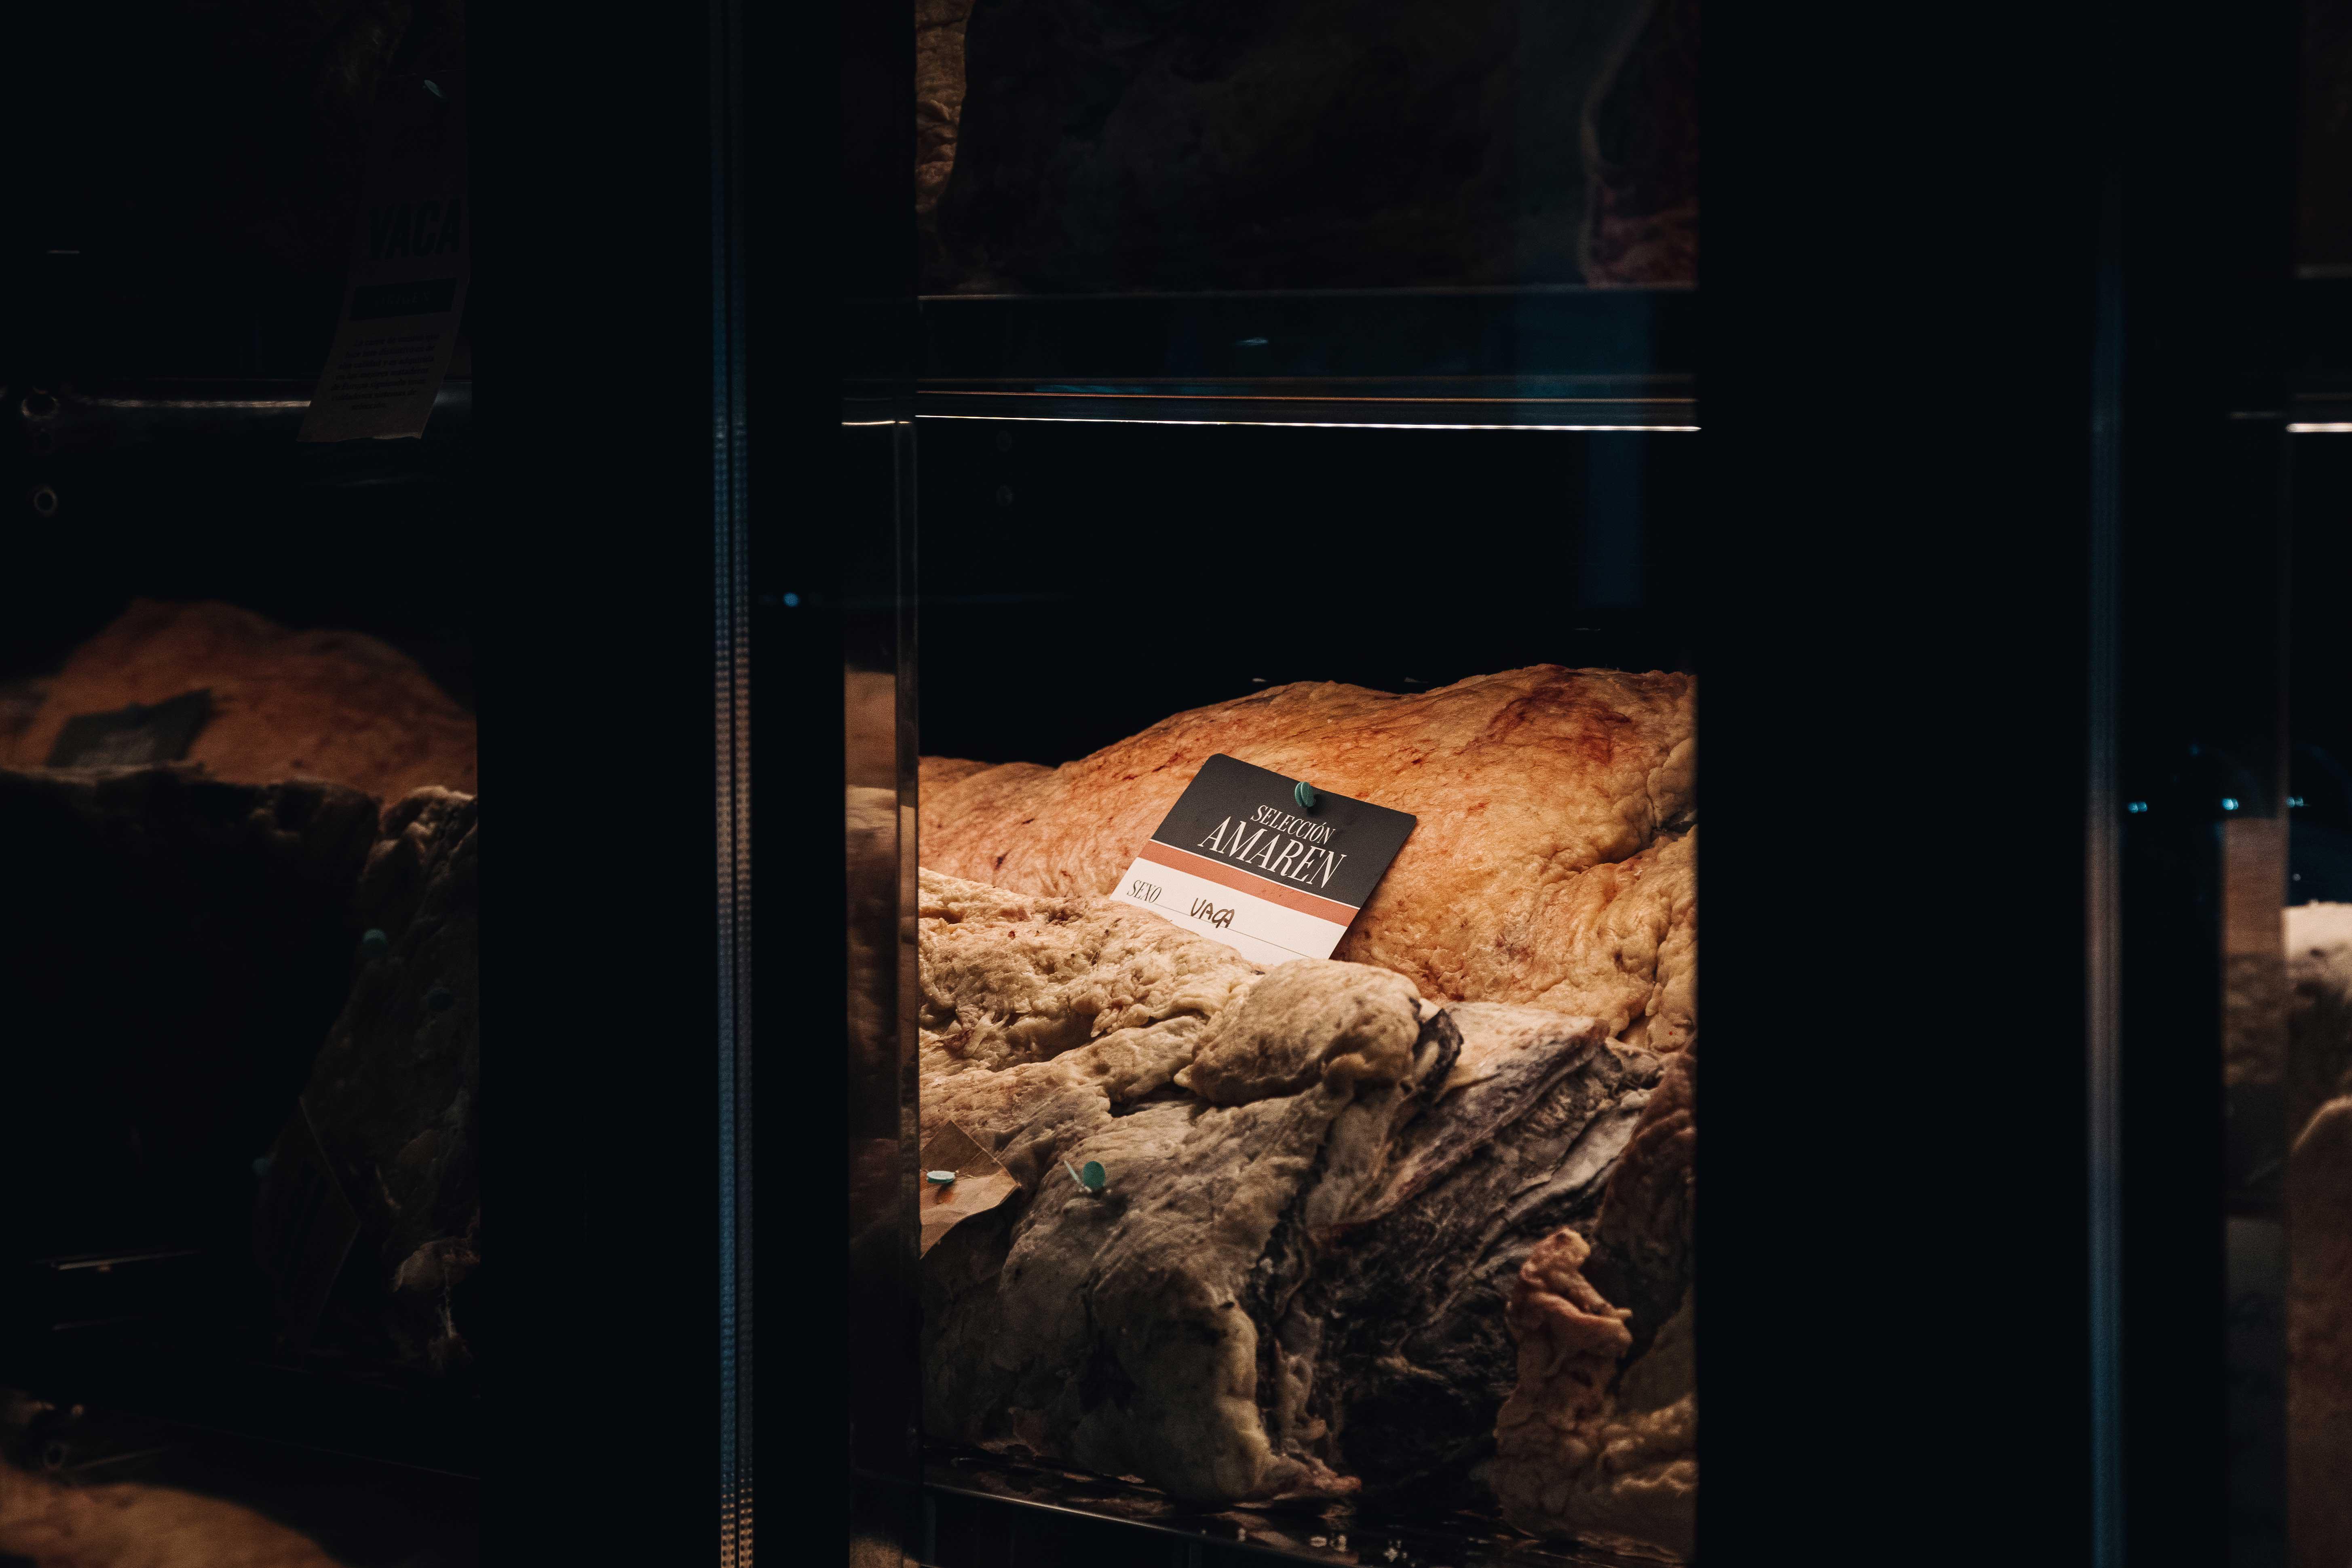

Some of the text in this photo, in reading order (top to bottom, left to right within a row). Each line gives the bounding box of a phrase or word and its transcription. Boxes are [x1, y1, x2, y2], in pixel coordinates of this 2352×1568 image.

[369, 198, 460, 260] VACA
[1250, 805, 1336, 845] SELECCIÓN
[1197, 816, 1347, 888] AMAREN
[1127, 880, 1162, 903] SEXO
[1191, 898, 1235, 928] VACA
